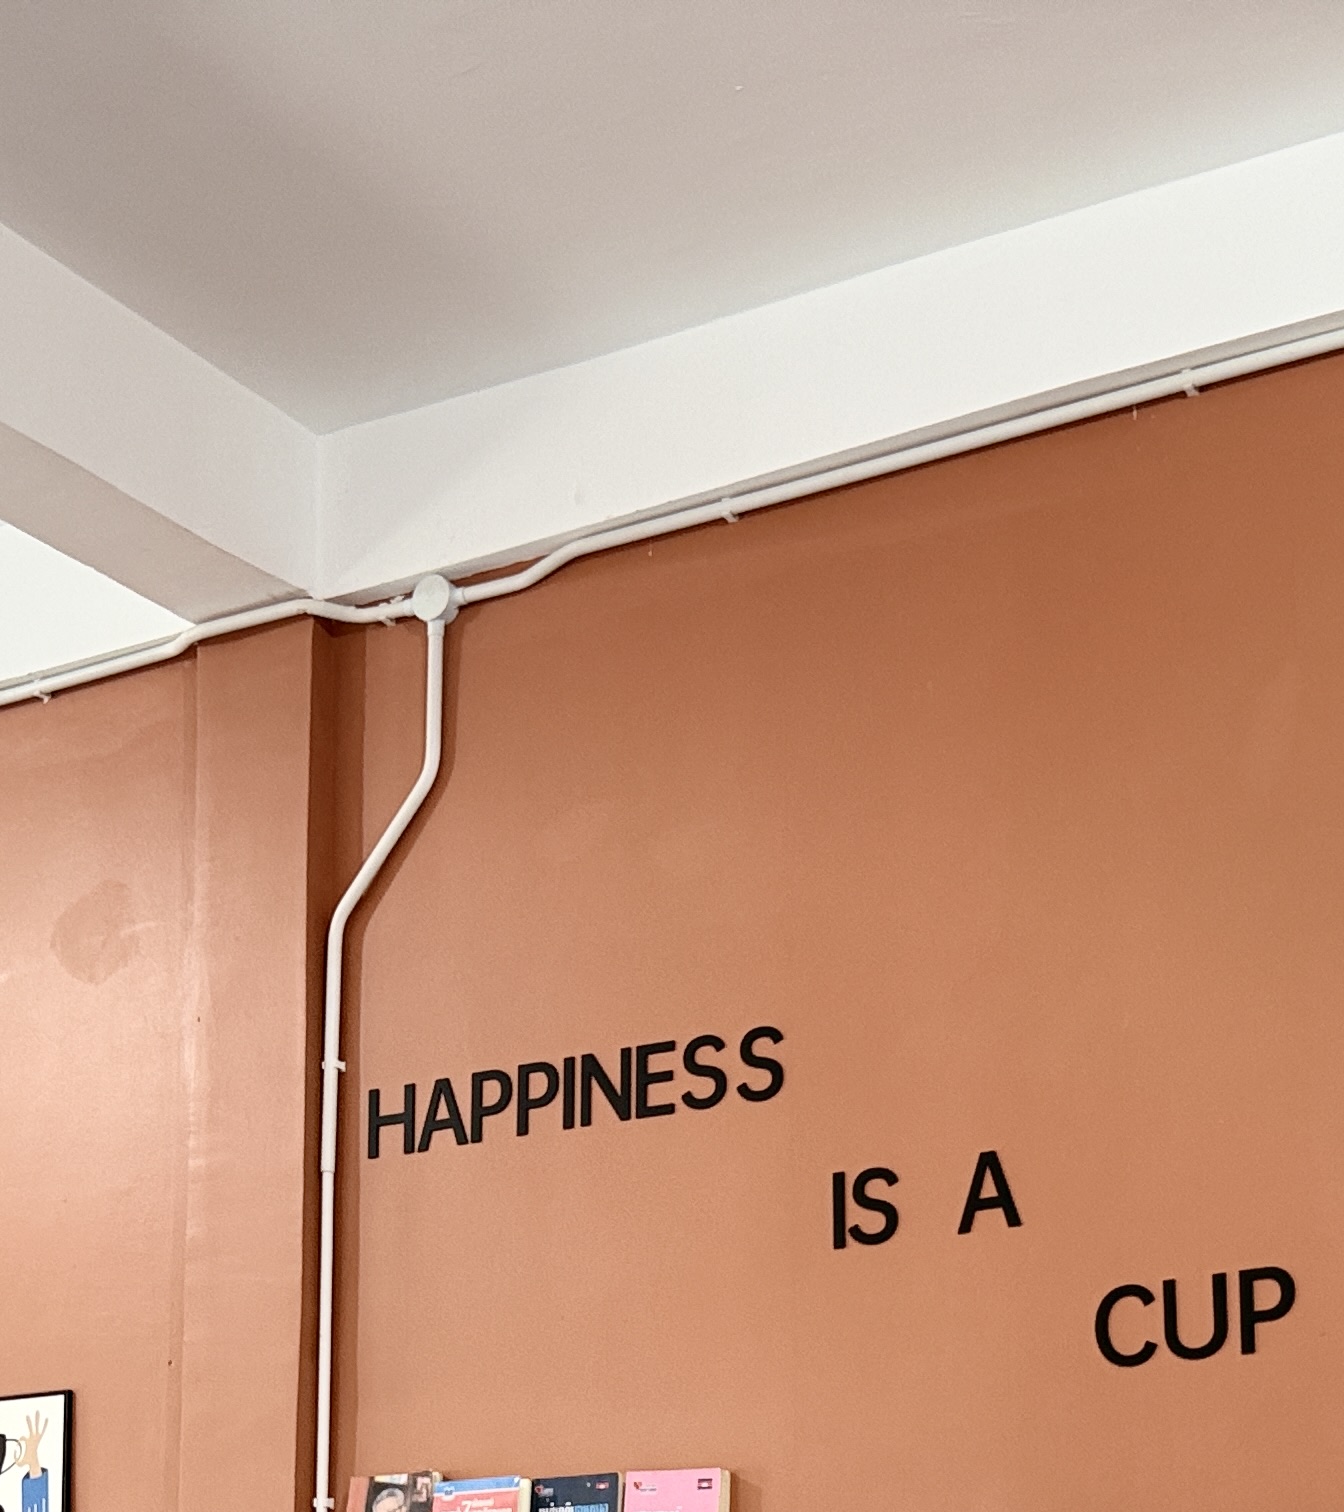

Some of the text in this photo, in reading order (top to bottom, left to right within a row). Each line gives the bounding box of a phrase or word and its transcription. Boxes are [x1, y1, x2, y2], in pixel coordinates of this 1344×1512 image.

[367, 1026, 785, 1160] HAPPINESS
[832, 1150, 1023, 1250] IS A
[1094, 1266, 1296, 1368] CUP
